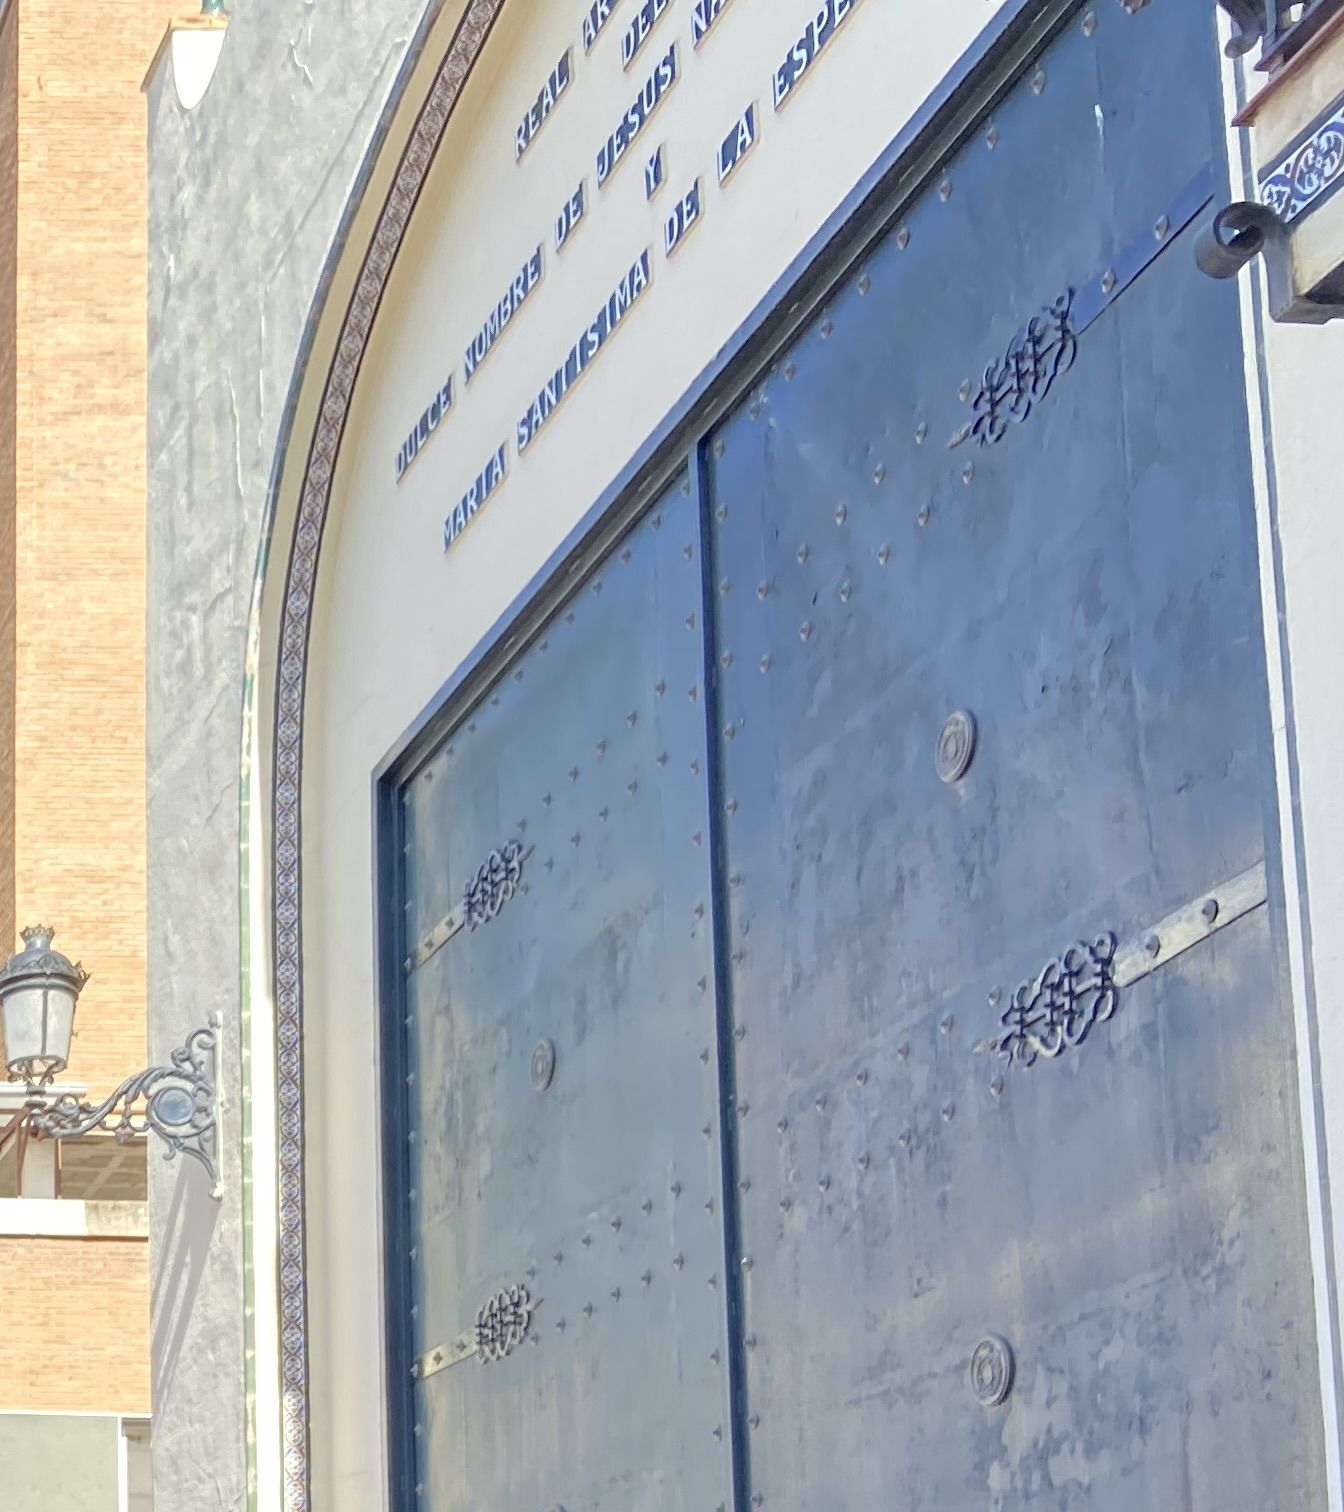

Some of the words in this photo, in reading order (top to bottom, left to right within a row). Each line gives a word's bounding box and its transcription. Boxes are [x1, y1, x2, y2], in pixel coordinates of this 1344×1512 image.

[515, 54, 571, 158] REAL
[645, 146, 662, 197] Y
[395, 376, 452, 480] DULCE
[464, 246, 543, 384] NOMBRE
[554, 182, 584, 249] DE
[596, 44, 676, 184] JESUS
[443, 445, 506, 549] MARIA
[517, 248, 649, 453] SANTISIMA
[664, 181, 702, 255] DE
[717, 102, 756, 184] LA
